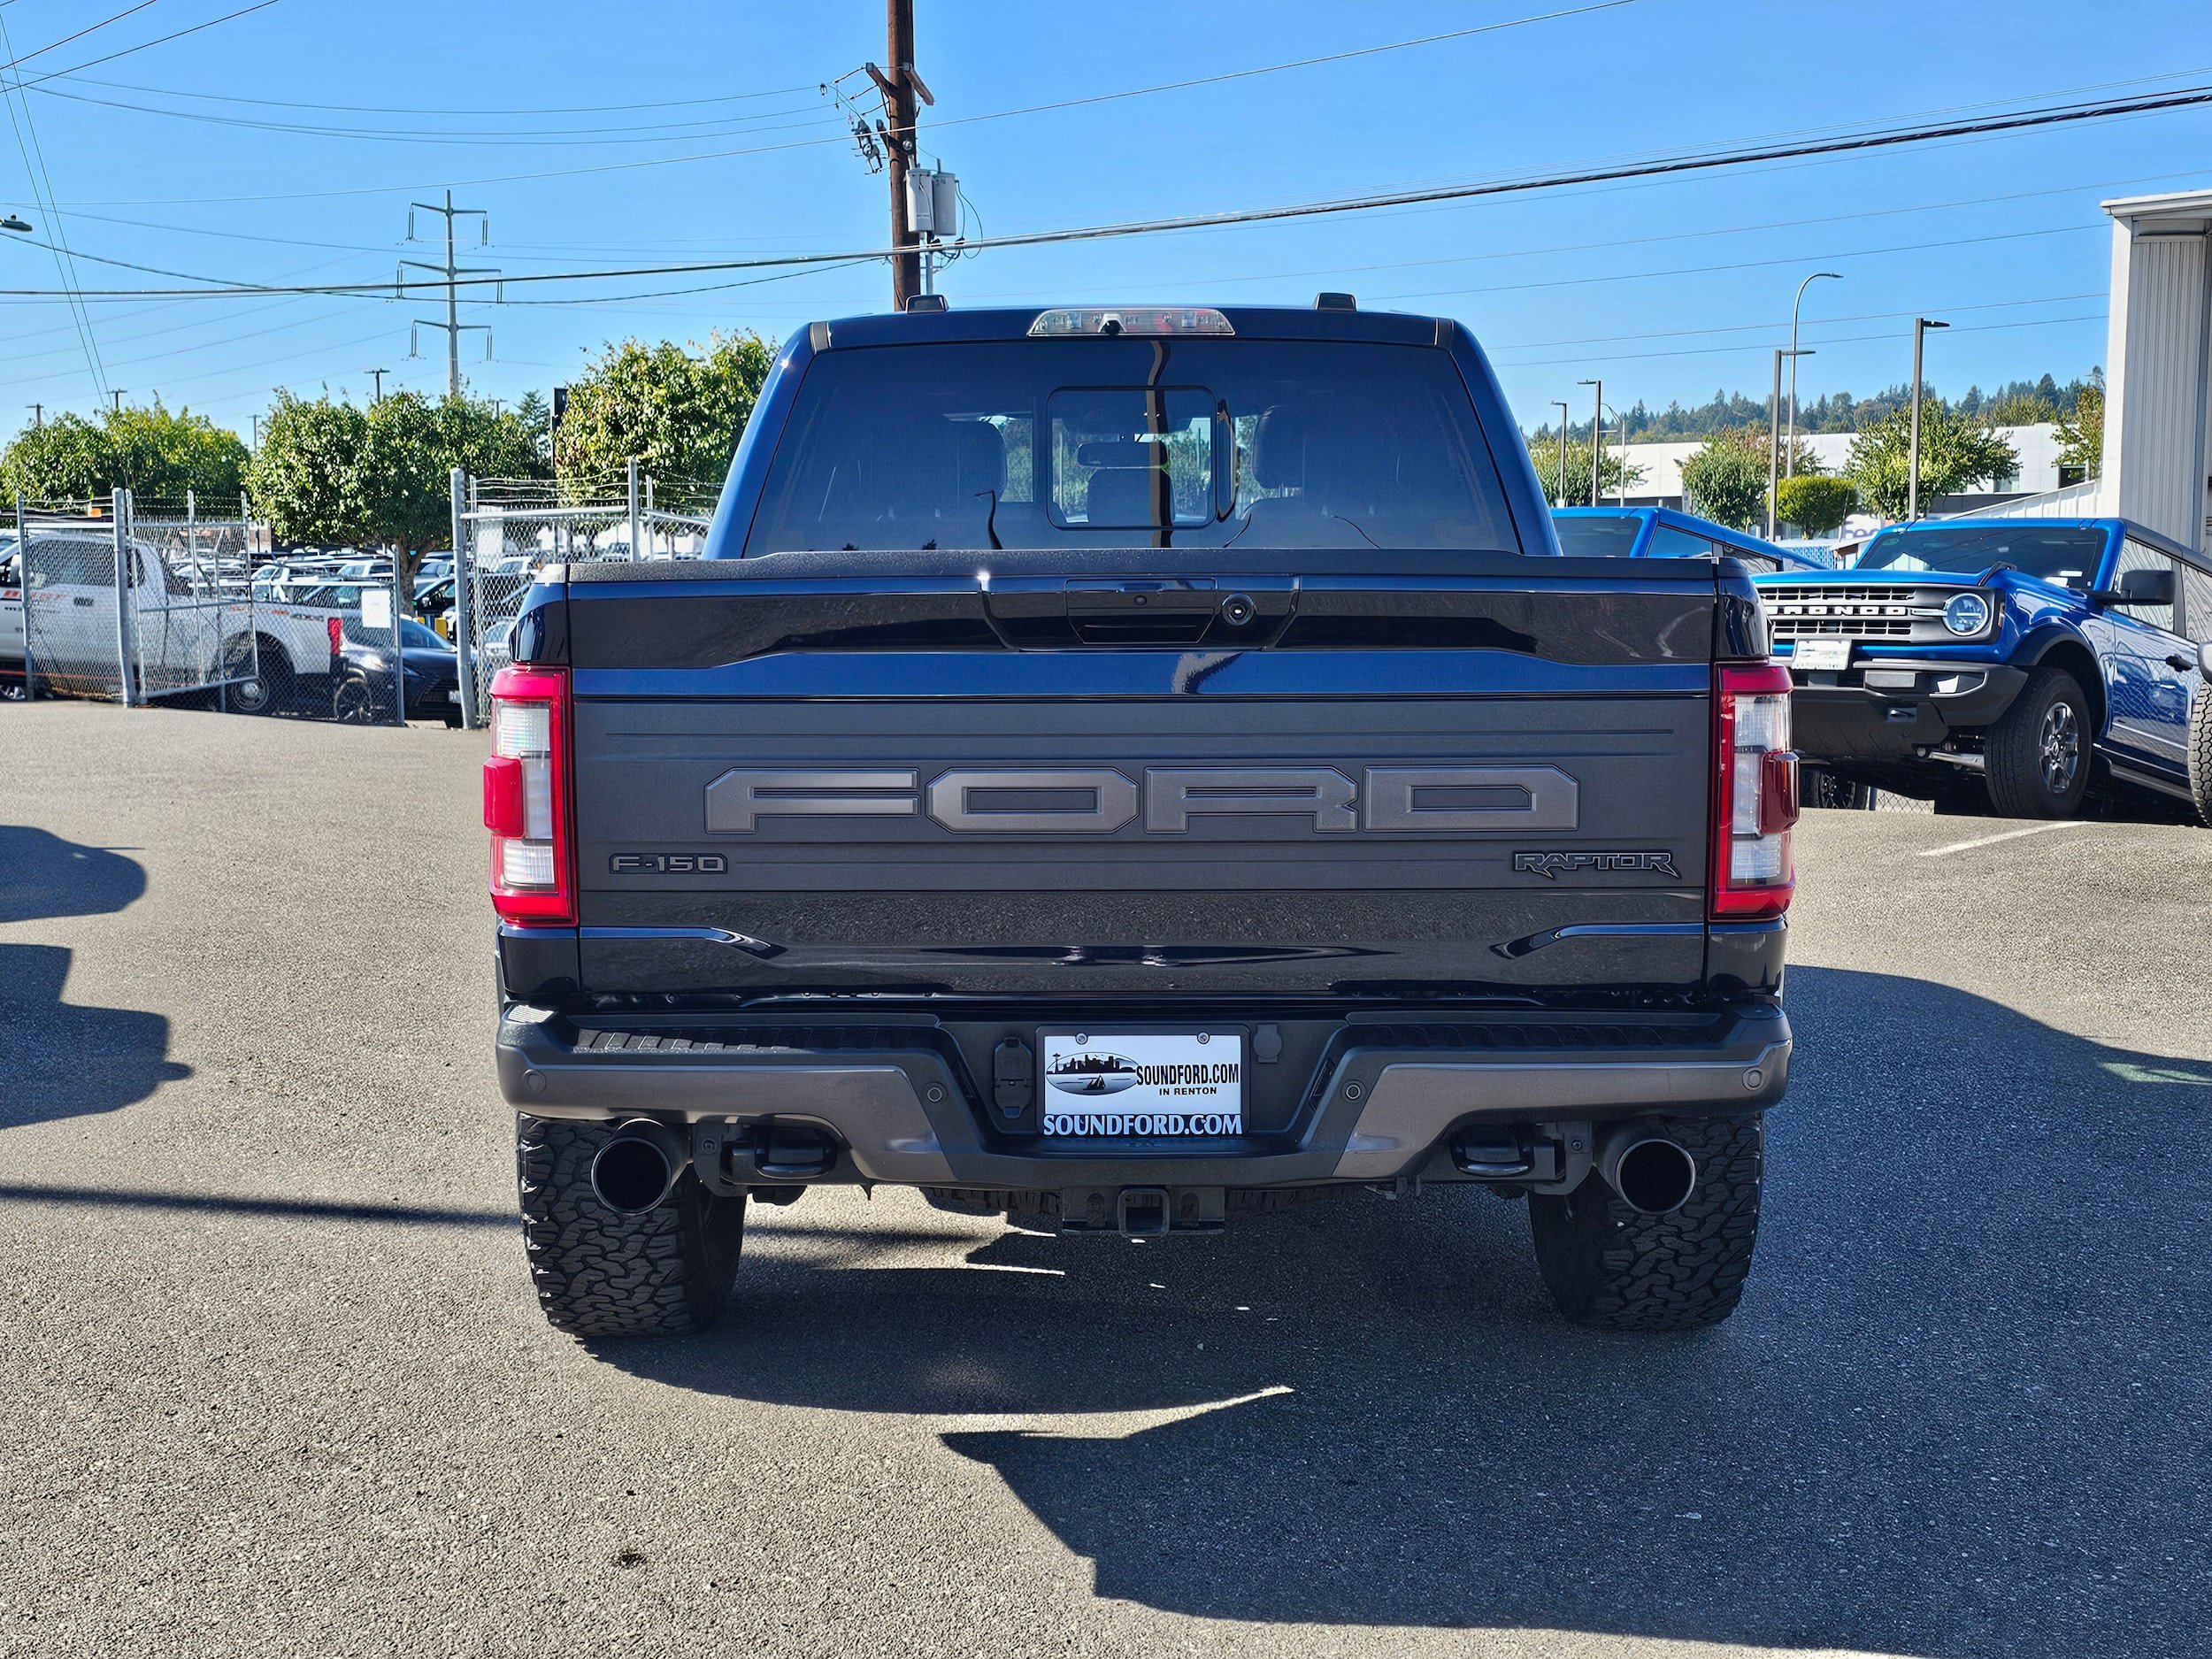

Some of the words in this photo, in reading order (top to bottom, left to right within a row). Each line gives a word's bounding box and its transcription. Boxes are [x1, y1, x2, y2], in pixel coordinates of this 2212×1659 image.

[704, 765, 1579, 834] FORD
[612, 856, 725, 872] F-150
[1514, 852, 1680, 879] RAPTOR
[1136, 1064, 1240, 1086] SOUNDFORD.COM
[1173, 1087, 1217, 1096] RENTON
[1042, 1114, 1243, 1136] SOUNDFORD.COM
